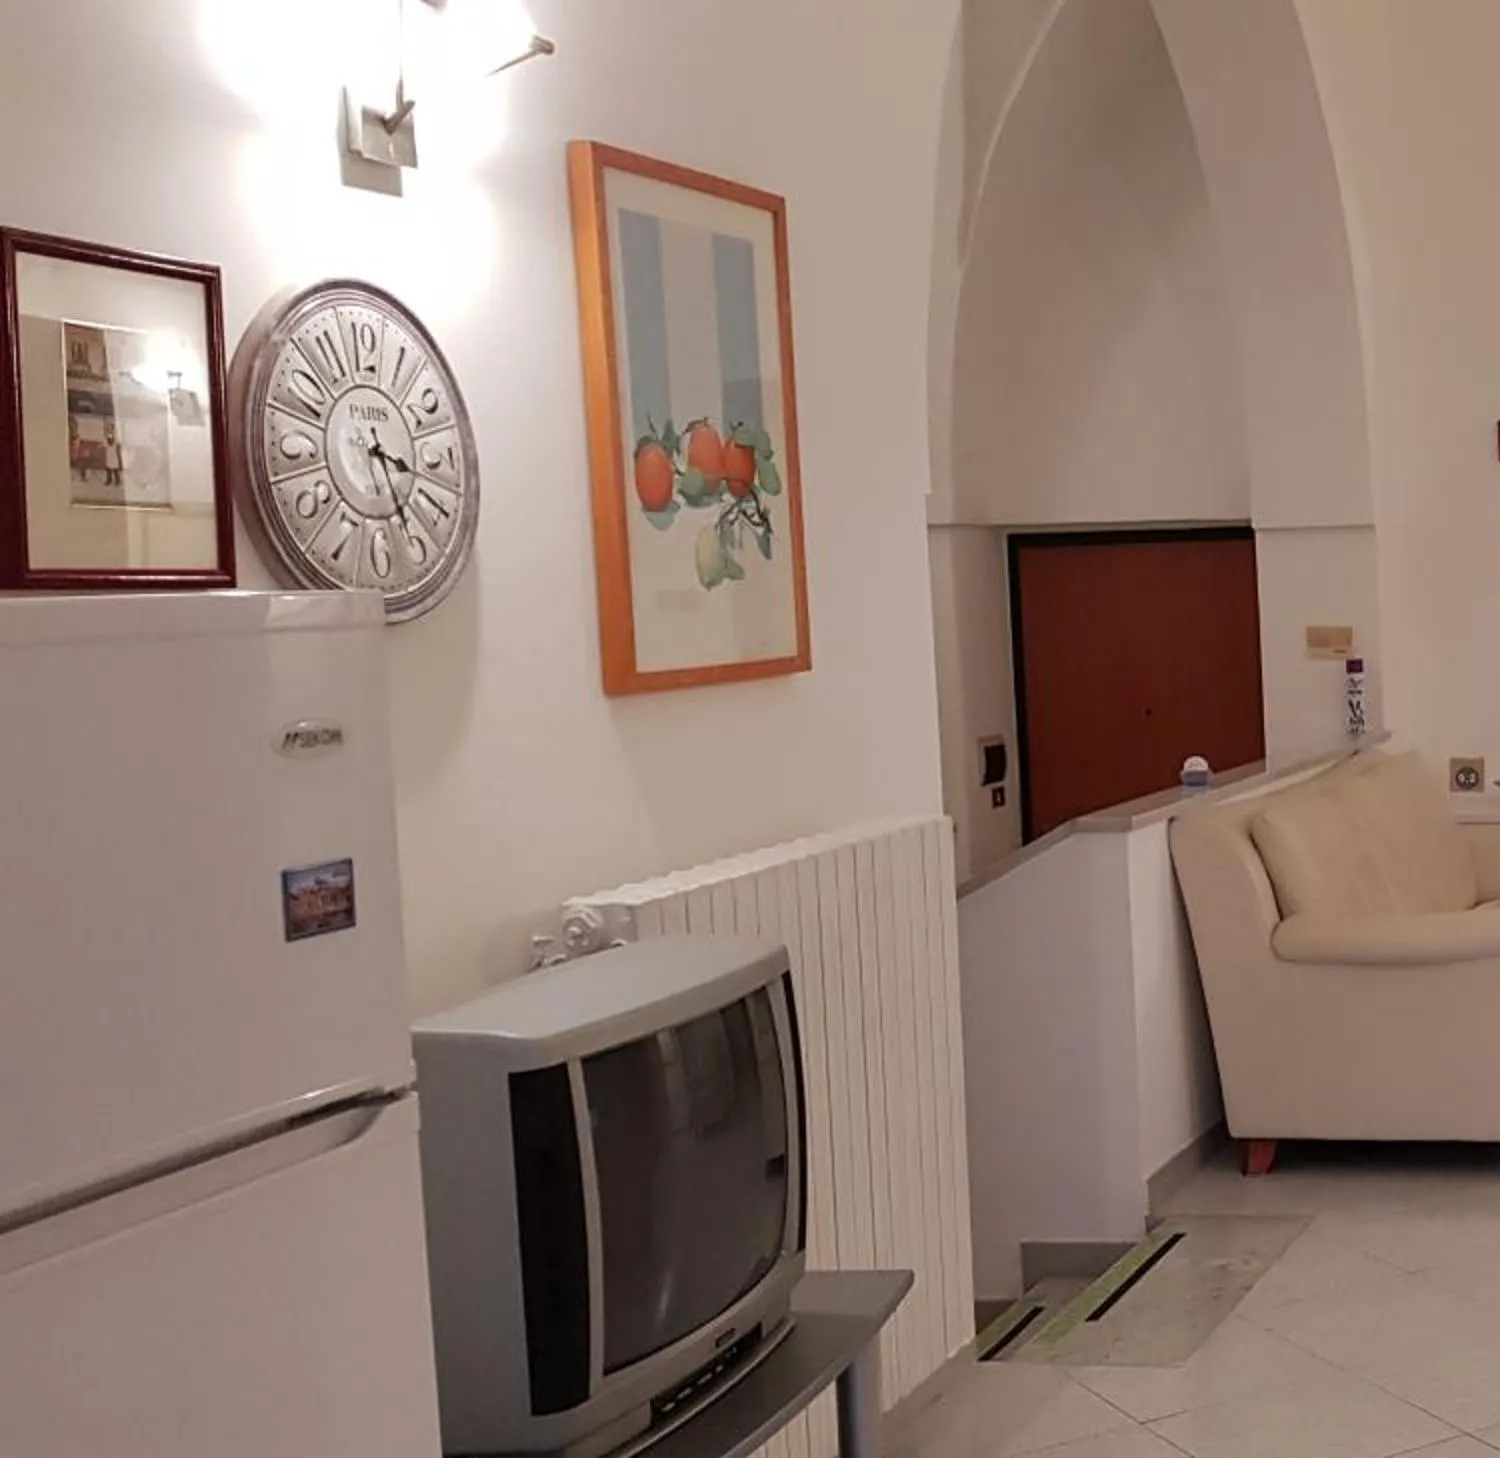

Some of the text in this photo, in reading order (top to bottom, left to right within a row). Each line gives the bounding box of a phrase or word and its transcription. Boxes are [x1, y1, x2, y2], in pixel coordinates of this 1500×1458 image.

[314, 329, 347, 386] 11
[350, 320, 377, 374] 12
[390, 346, 406, 389] 1
[288, 368, 326, 419] 10
[349, 403, 389, 421] PARIS
[406, 387, 440, 429] 2
[279, 429, 319, 459] 9
[420, 441, 457, 471] 3
[295, 478, 332, 520] 8
[330, 510, 360, 562] 7
[369, 527, 392, 579] 6
